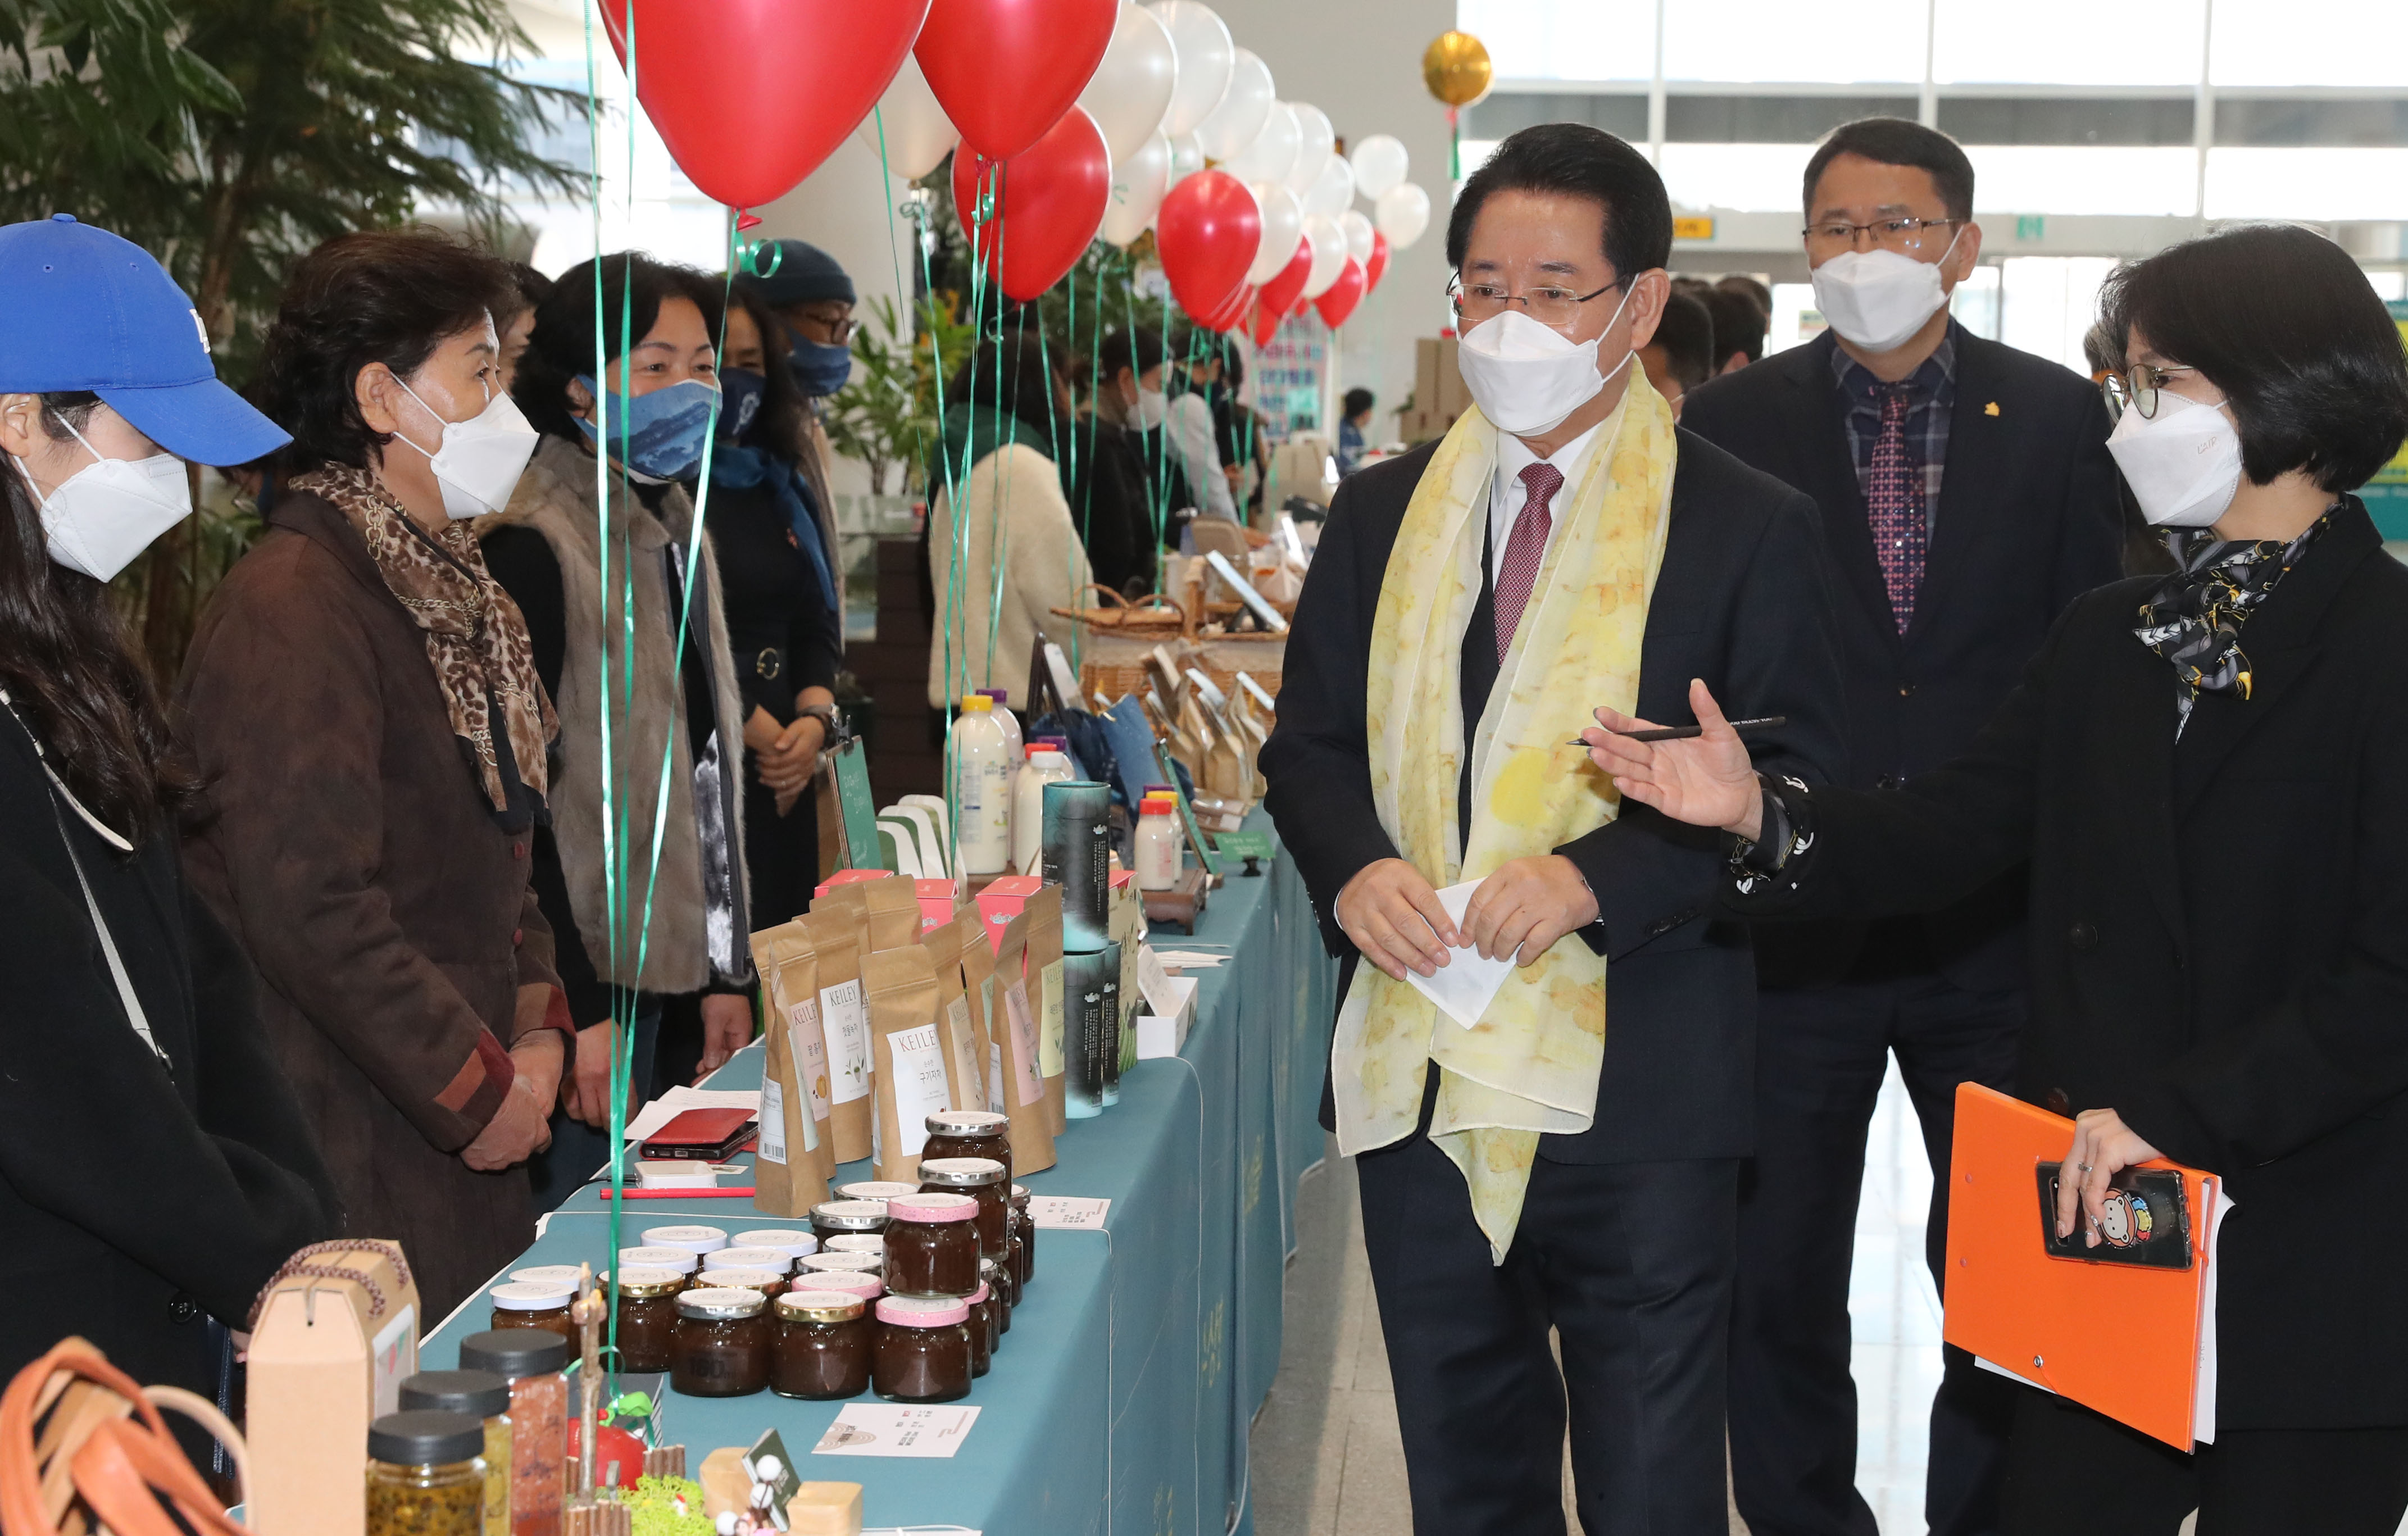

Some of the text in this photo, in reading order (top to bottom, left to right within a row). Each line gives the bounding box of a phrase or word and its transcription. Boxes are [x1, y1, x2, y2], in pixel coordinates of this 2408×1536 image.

[829, 985, 857, 1007] KEILEY
[793, 1003, 817, 1025] KEILE
[920, 1069, 942, 1084] 구기자차
